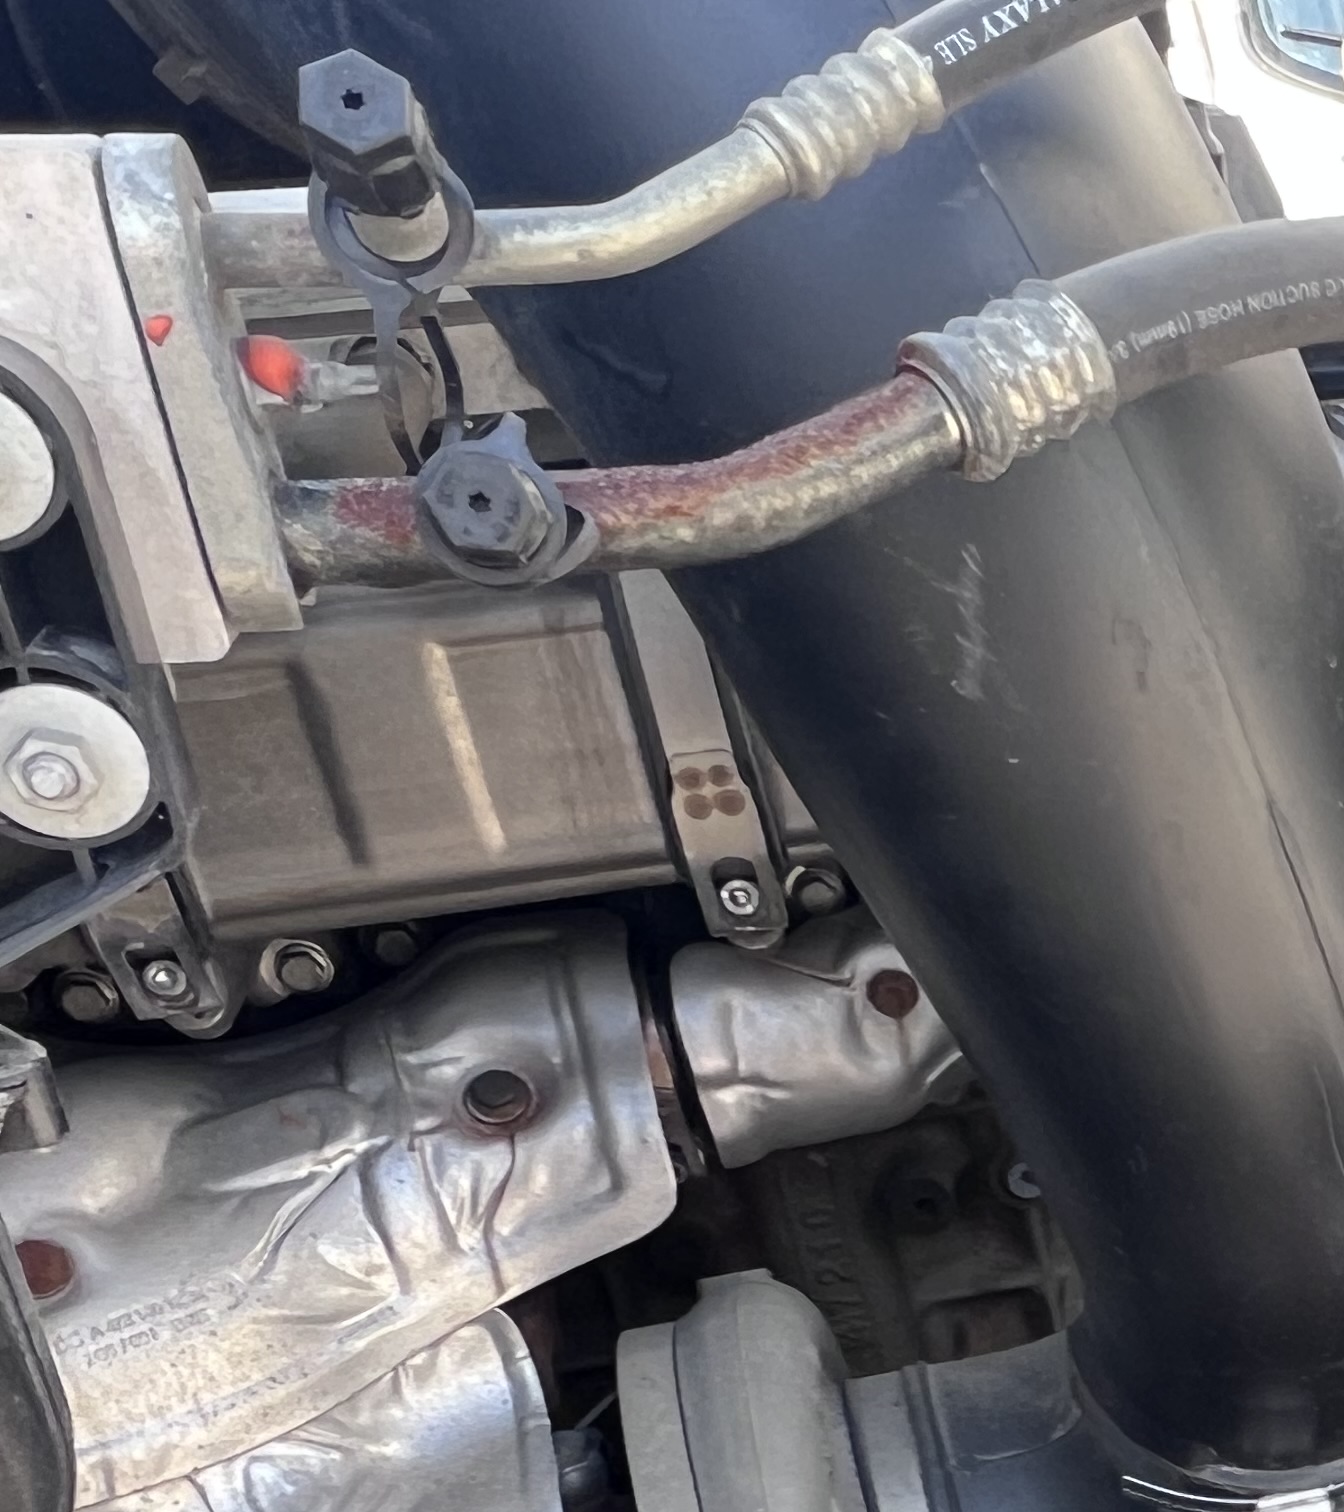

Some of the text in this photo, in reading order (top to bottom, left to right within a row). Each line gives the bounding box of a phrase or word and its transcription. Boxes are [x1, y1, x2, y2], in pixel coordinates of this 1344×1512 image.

[934, 0, 1061, 65] LAXY SLE
[1246, 283, 1323, 315] SUCTION
[1193, 303, 1245, 331] HOSE
